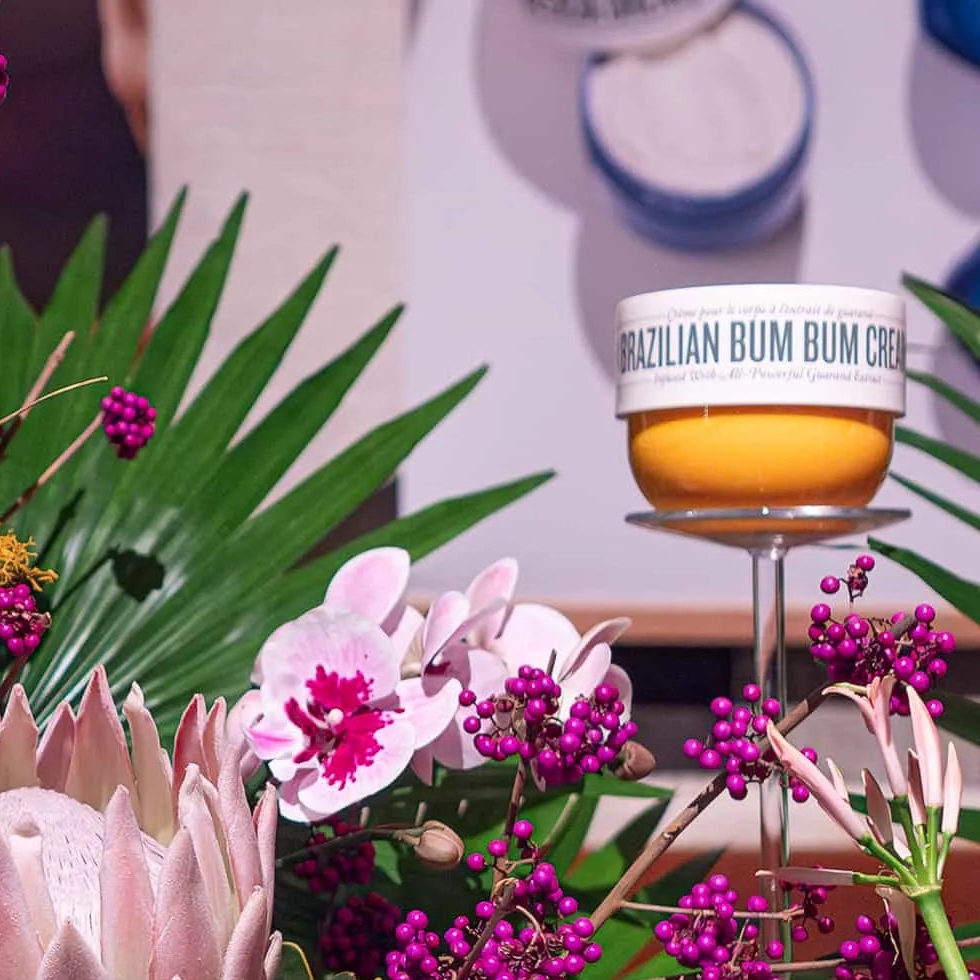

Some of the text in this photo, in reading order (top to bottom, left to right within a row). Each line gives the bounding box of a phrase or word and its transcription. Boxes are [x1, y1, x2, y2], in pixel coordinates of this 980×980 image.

[620, 320, 719, 375] BRAZILIAN
[730, 319, 793, 363] BUM
[803, 320, 859, 366] BUM
